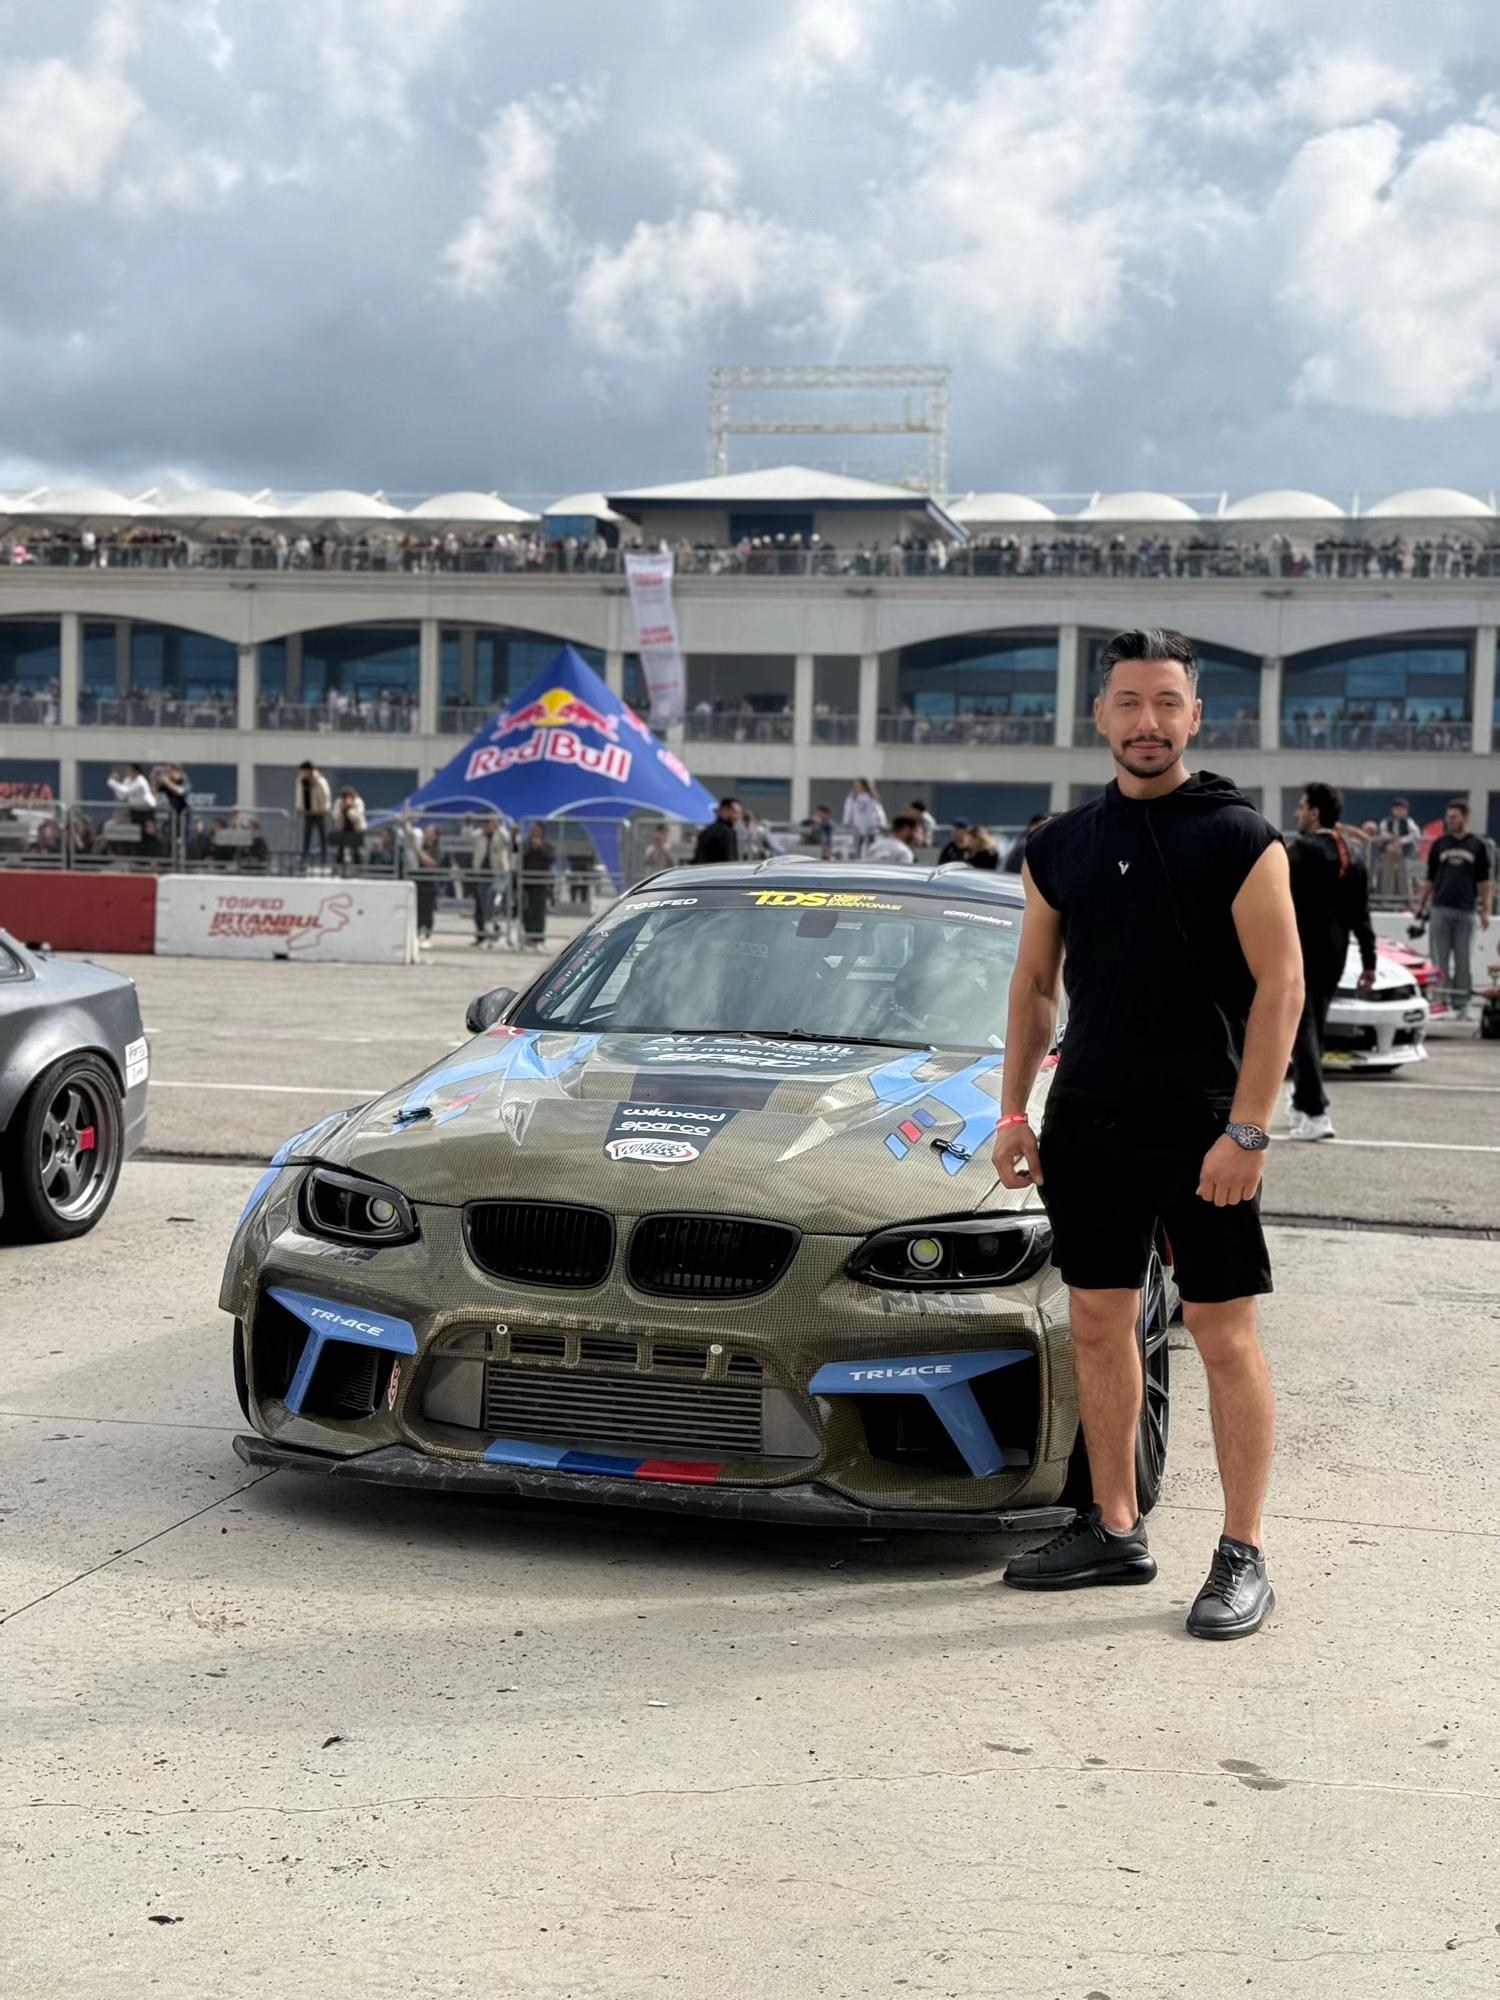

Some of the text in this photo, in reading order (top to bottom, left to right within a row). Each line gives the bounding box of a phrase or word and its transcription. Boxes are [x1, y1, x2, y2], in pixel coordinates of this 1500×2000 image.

[465, 729, 545, 781] Red
[545, 727, 632, 783] Bull
[215, 896, 284, 910] TOSFED
[624, 898, 698, 911] TOSFED
[744, 891, 830, 907] TDS
[700, 1048, 840, 1063] motorsport
[622, 1107, 727, 1122] wilwood
[617, 1121, 711, 1136] sparco
[310, 1302, 385, 1337] TRI-ACE
[848, 1364, 953, 1381] TRI-ACE
